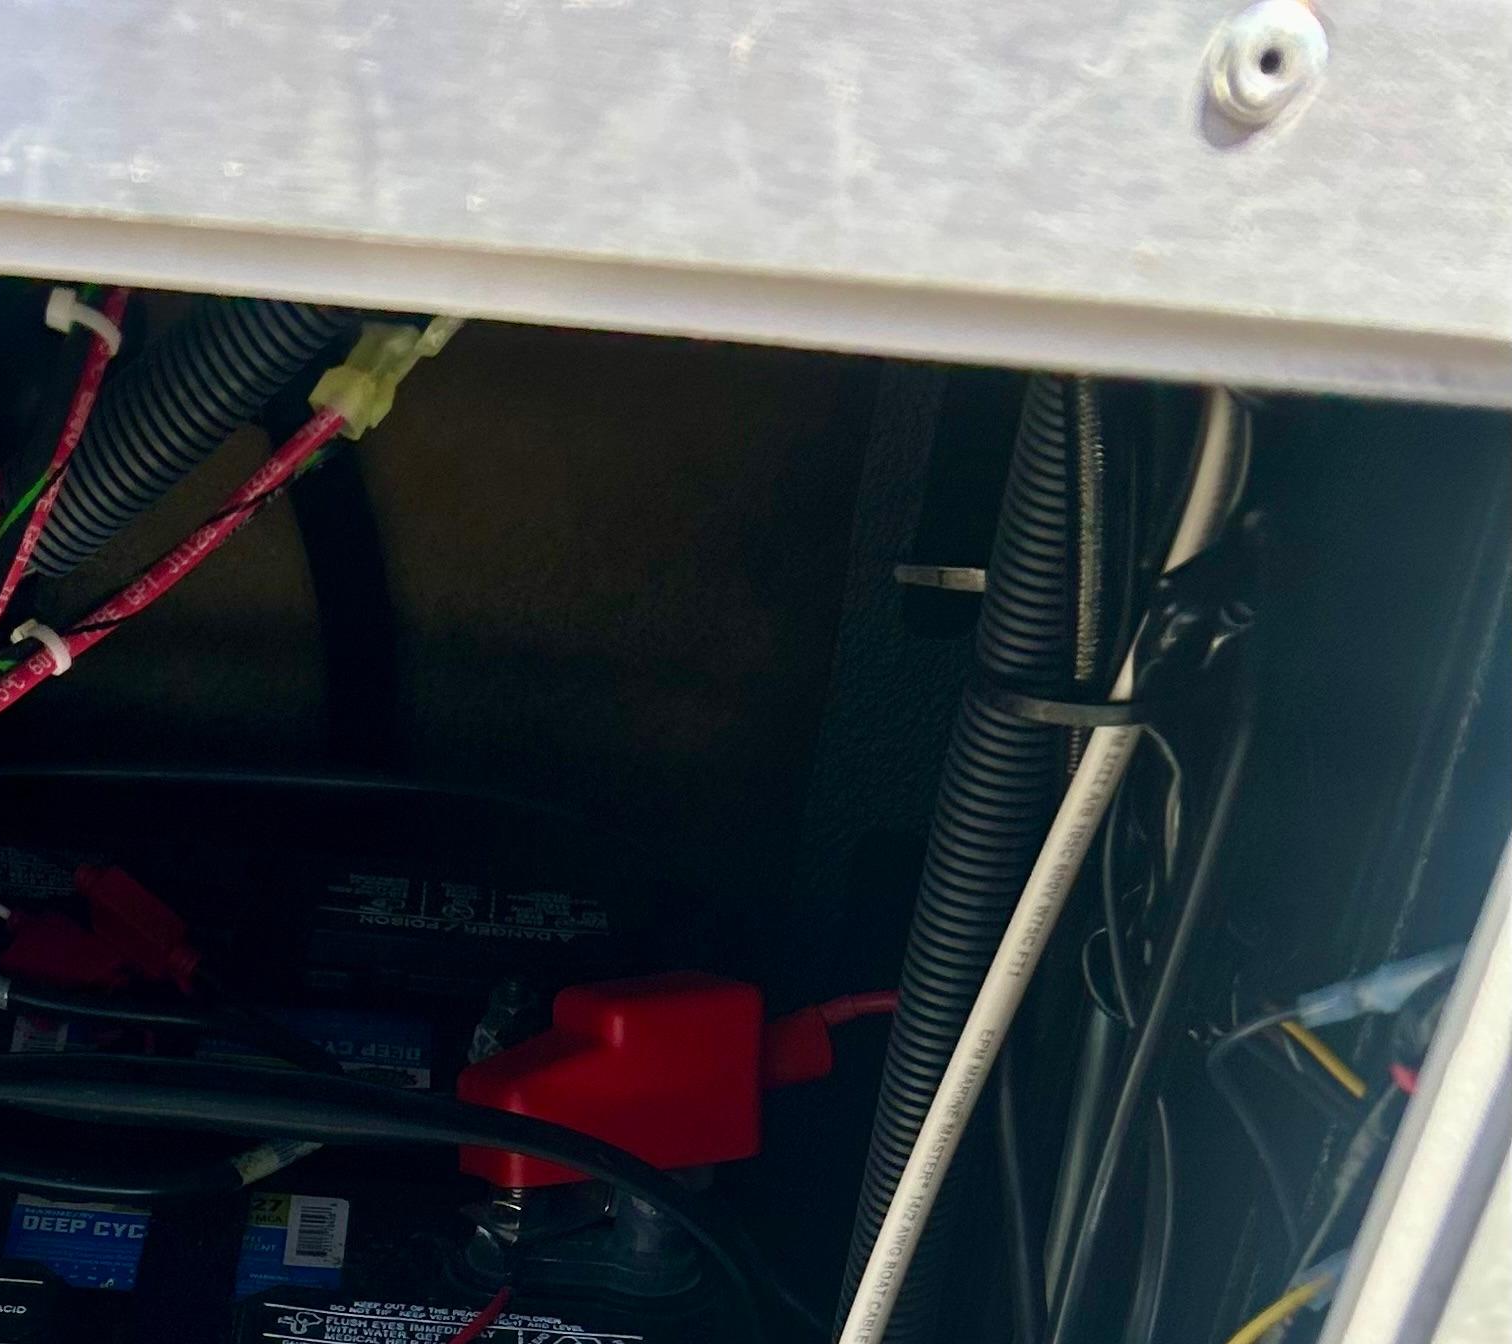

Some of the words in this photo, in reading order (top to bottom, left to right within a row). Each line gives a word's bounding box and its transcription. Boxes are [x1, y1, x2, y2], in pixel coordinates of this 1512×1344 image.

[946, 1062, 980, 1121] MARINE
[23, 1215, 86, 1234] DEEP
[93, 1221, 146, 1240] CYC
[886, 1224, 909, 1259] AWG
[873, 1260, 896, 1296] BOAT
[349, 1306, 370, 1315] NOT
[528, 1321, 549, 1330] AND
[353, 1301, 382, 1310] KEEP
[384, 1302, 406, 1311] OUT
[429, 1306, 448, 1315] THE
[453, 1308, 481, 1318] REAC
[509, 1312, 562, 1325] CHILDREN
[856, 1300, 881, 1344] CABLE
[324, 1332, 380, 1344] MEDICAL
[325, 1316, 368, 1328] FLUSH
[372, 1318, 404, 1331] EYES
[410, 1321, 496, 1339] IMMEDIALY
[326, 1325, 358, 1336] WITH
[415, 1332, 442, 1342] GET
